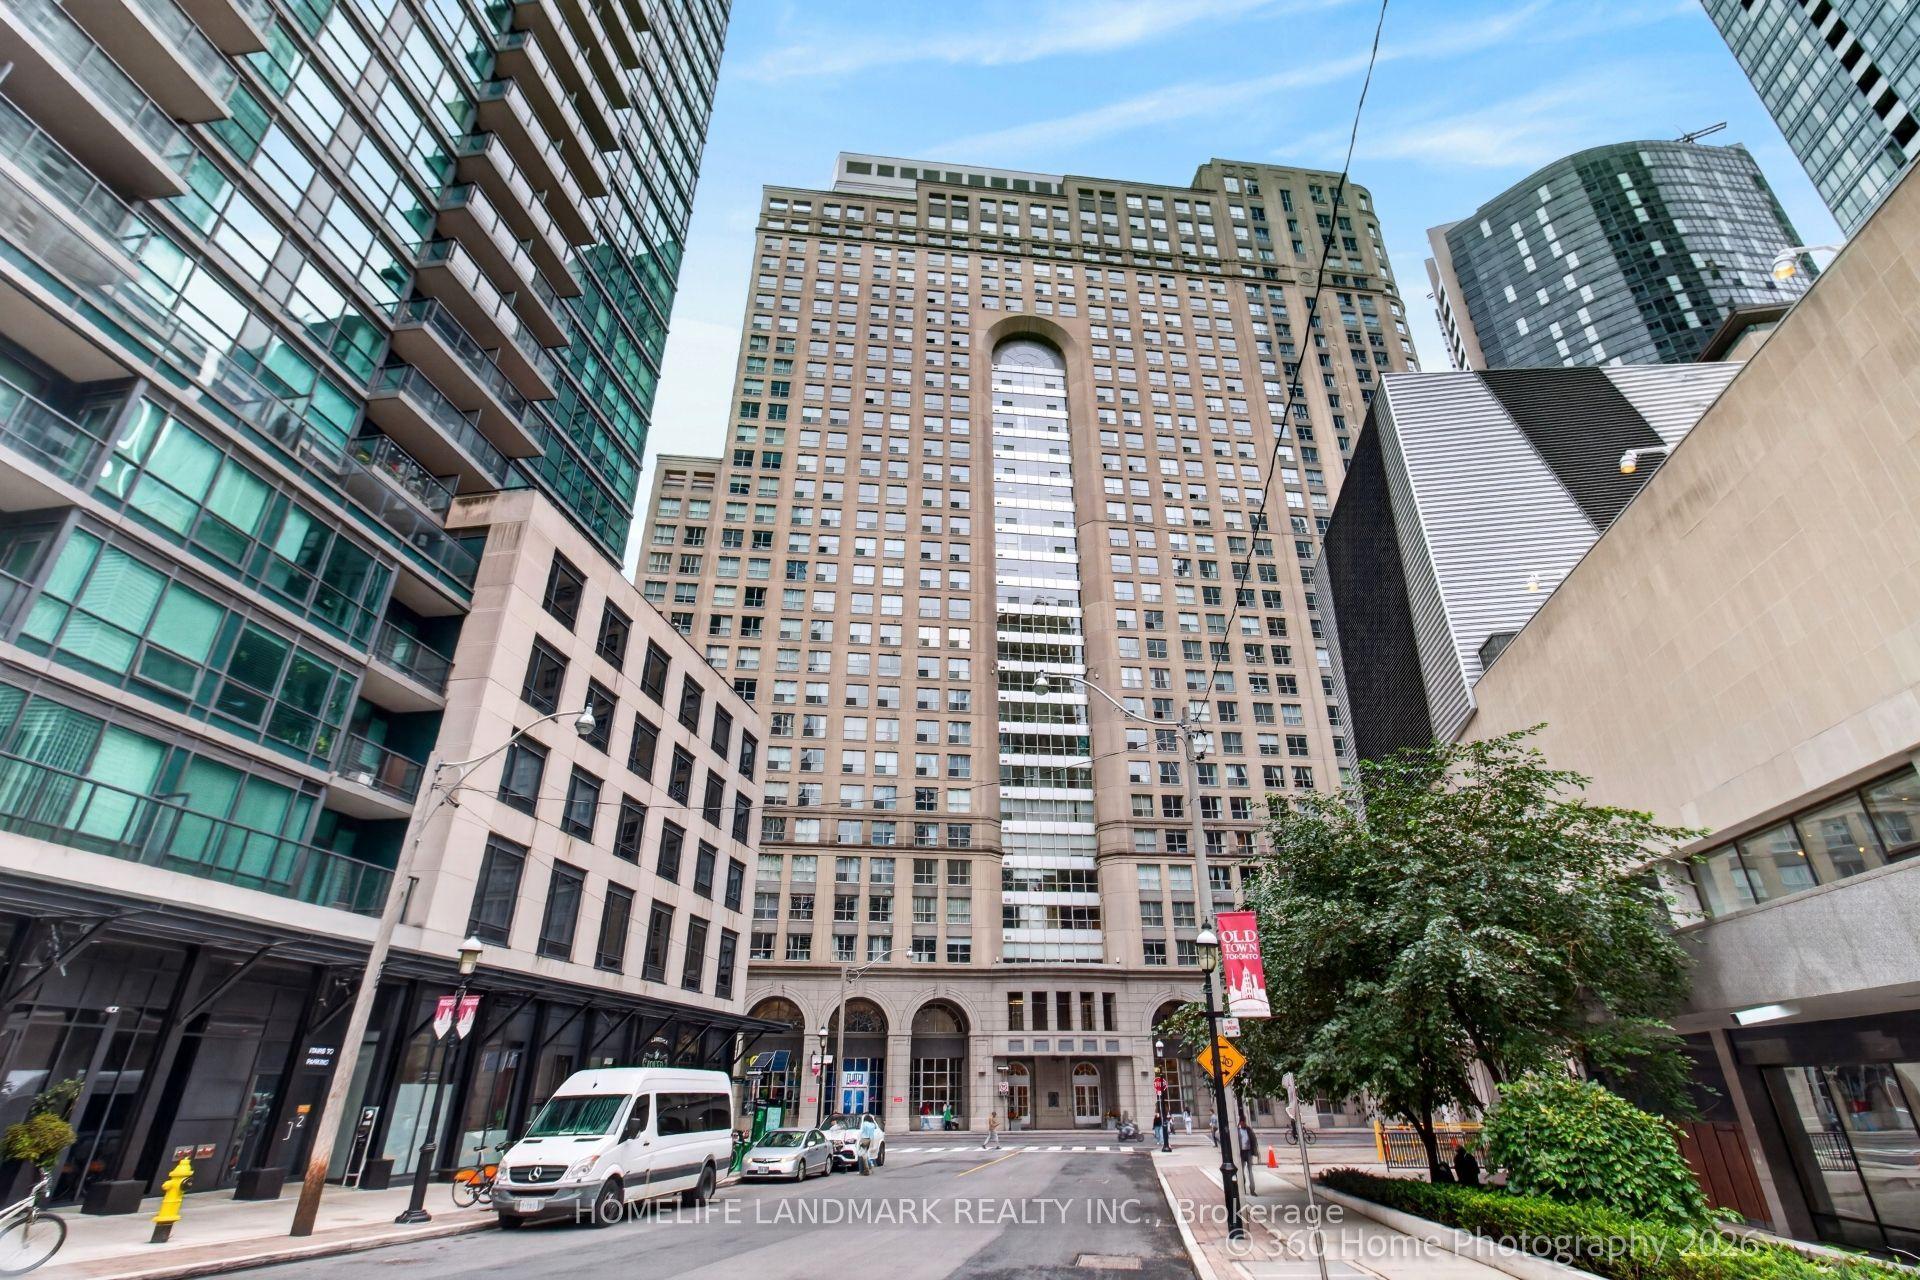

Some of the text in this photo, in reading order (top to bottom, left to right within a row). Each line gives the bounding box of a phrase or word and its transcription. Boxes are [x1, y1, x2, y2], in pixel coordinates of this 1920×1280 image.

[1221, 930, 1257, 943] OLD
[1224, 943, 1258, 953] TOWN
[296, 1115, 305, 1128] 2
